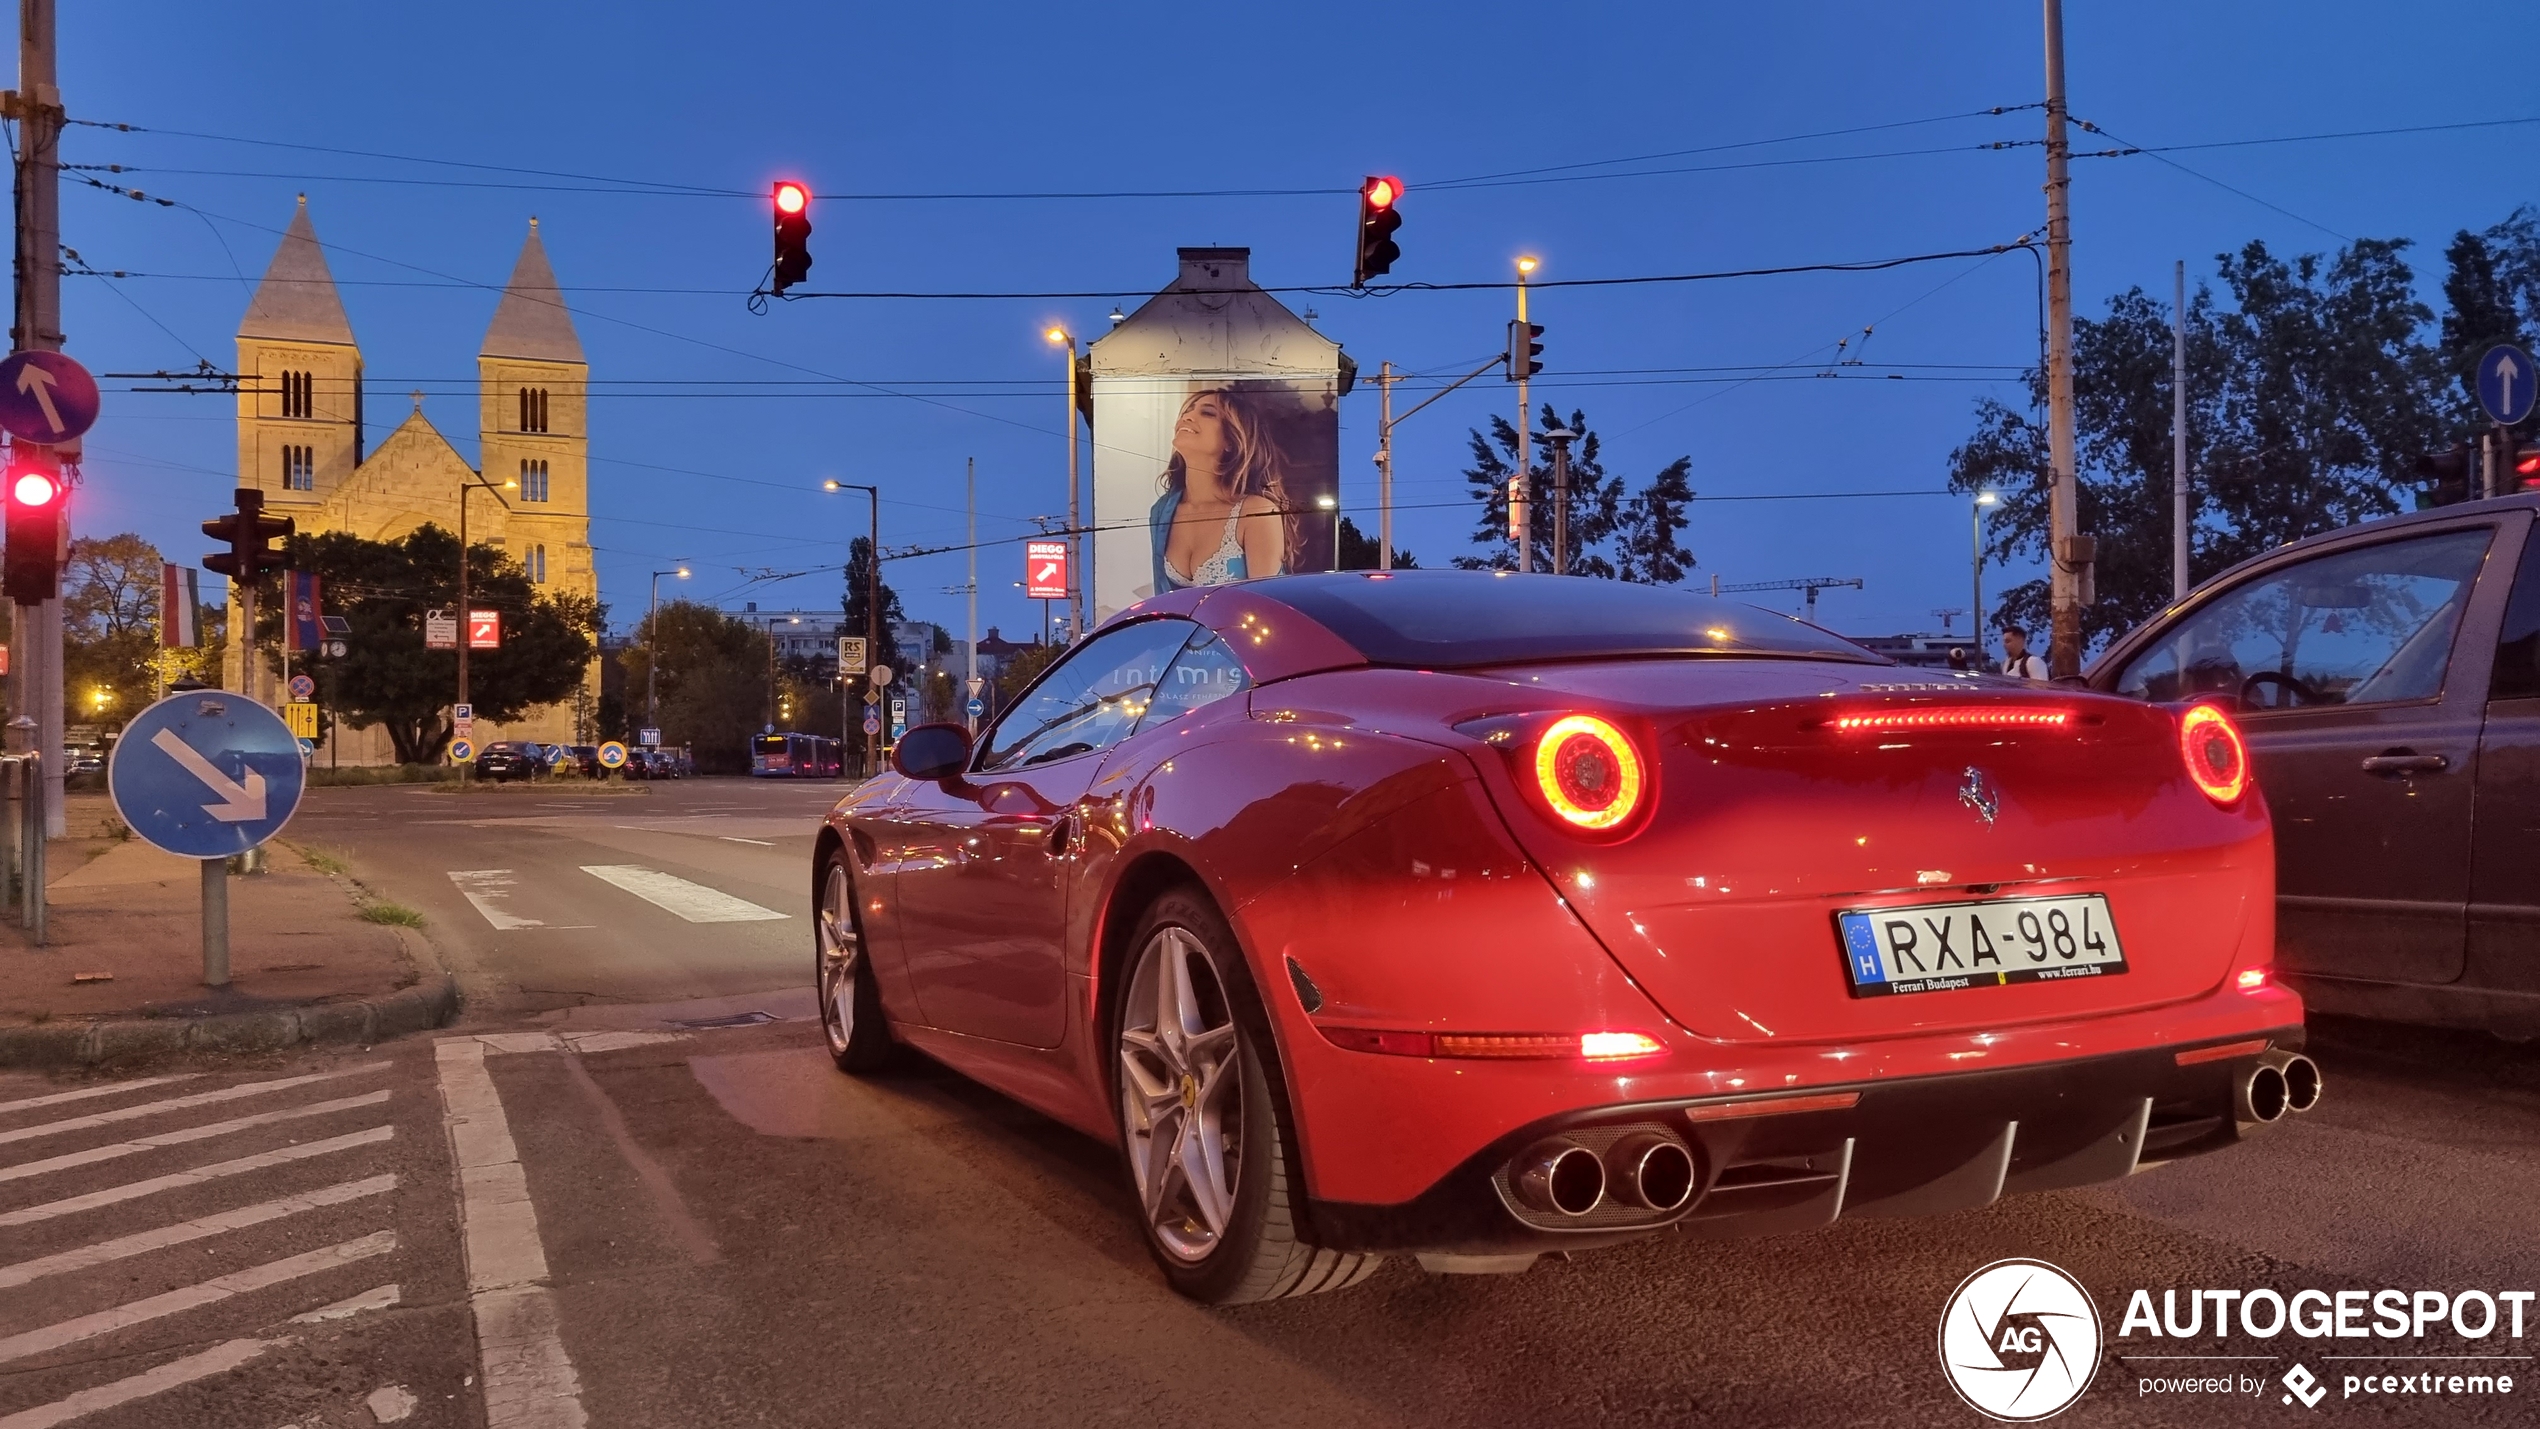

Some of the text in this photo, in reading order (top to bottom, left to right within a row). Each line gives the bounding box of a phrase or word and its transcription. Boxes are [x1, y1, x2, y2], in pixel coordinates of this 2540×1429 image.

[1029, 544, 1064, 554] DIEGO
[845, 641, 861, 652] RS
[1884, 907, 2107, 974] RXA-984
[1859, 954, 1876, 976] H
[2038, 964, 2102, 980] www.ferrari.hu
[1892, 975, 1969, 993] Ferrari Budapest
